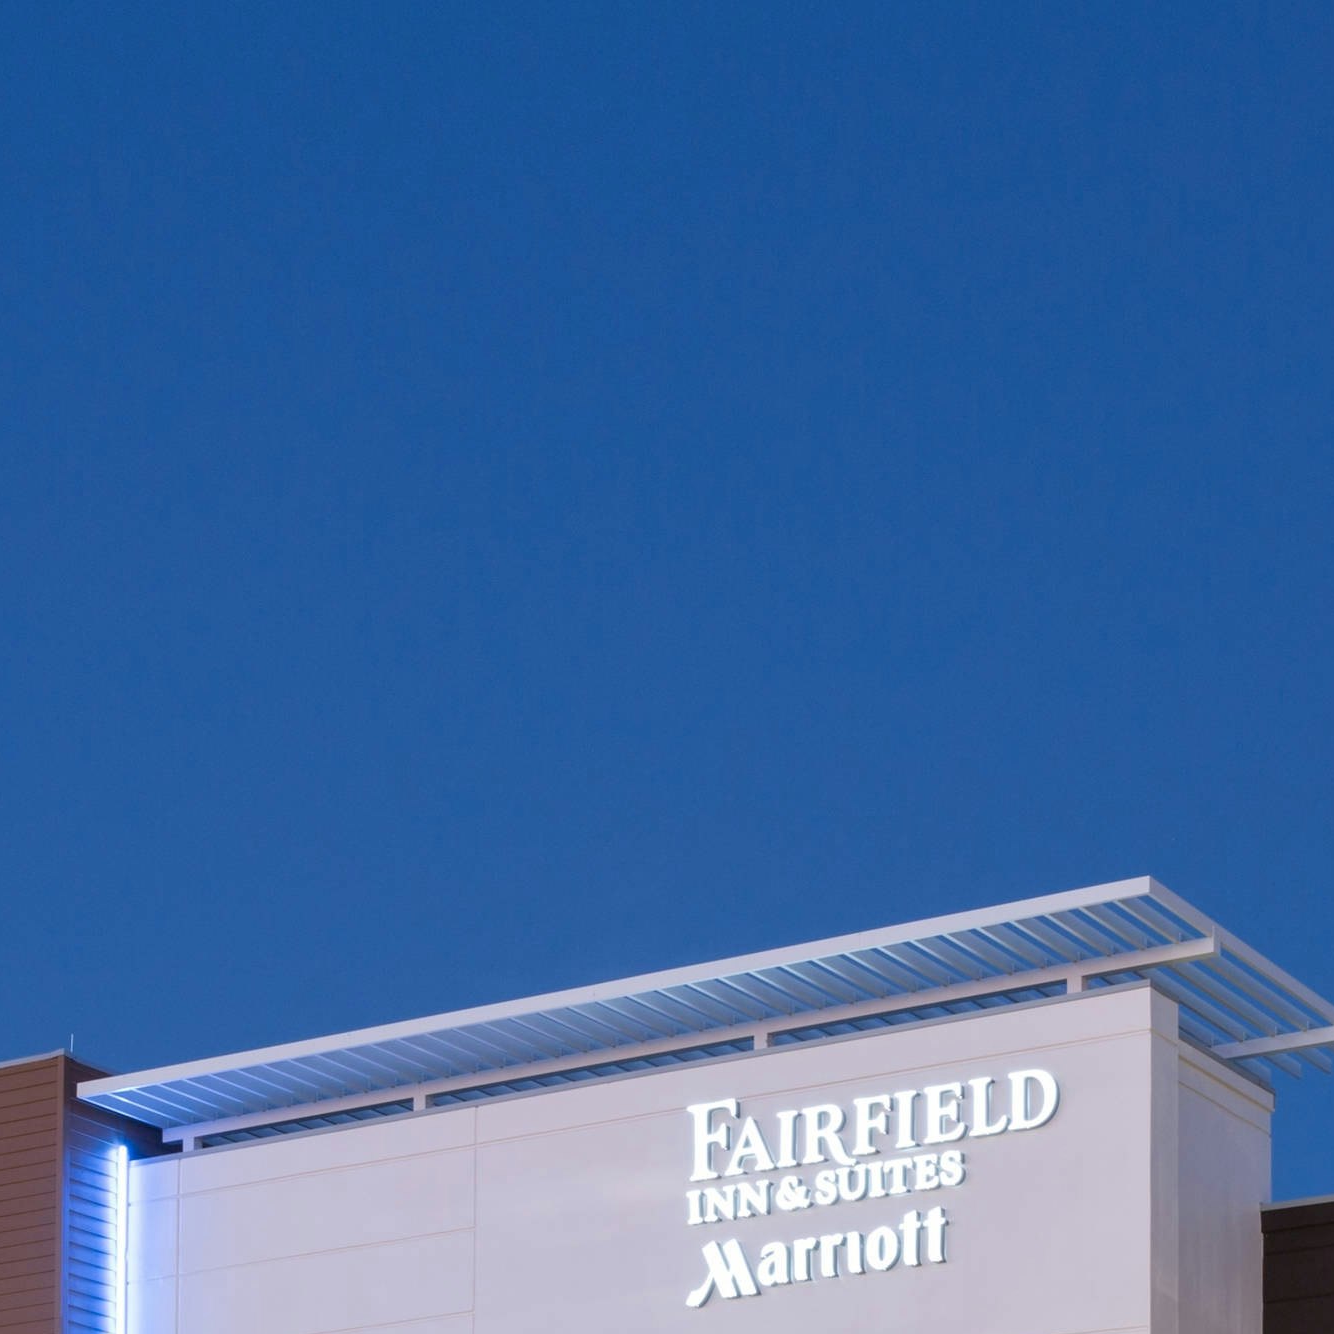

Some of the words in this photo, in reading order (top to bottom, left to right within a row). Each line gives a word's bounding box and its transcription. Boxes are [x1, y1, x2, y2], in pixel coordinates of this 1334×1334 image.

[686, 1069, 1059, 1182] FAIRFIELD
[685, 1179, 772, 1225] INN
[775, 1176, 812, 1211] &
[814, 1150, 966, 1206] SUITES
[685, 1206, 950, 1308] Marriott
